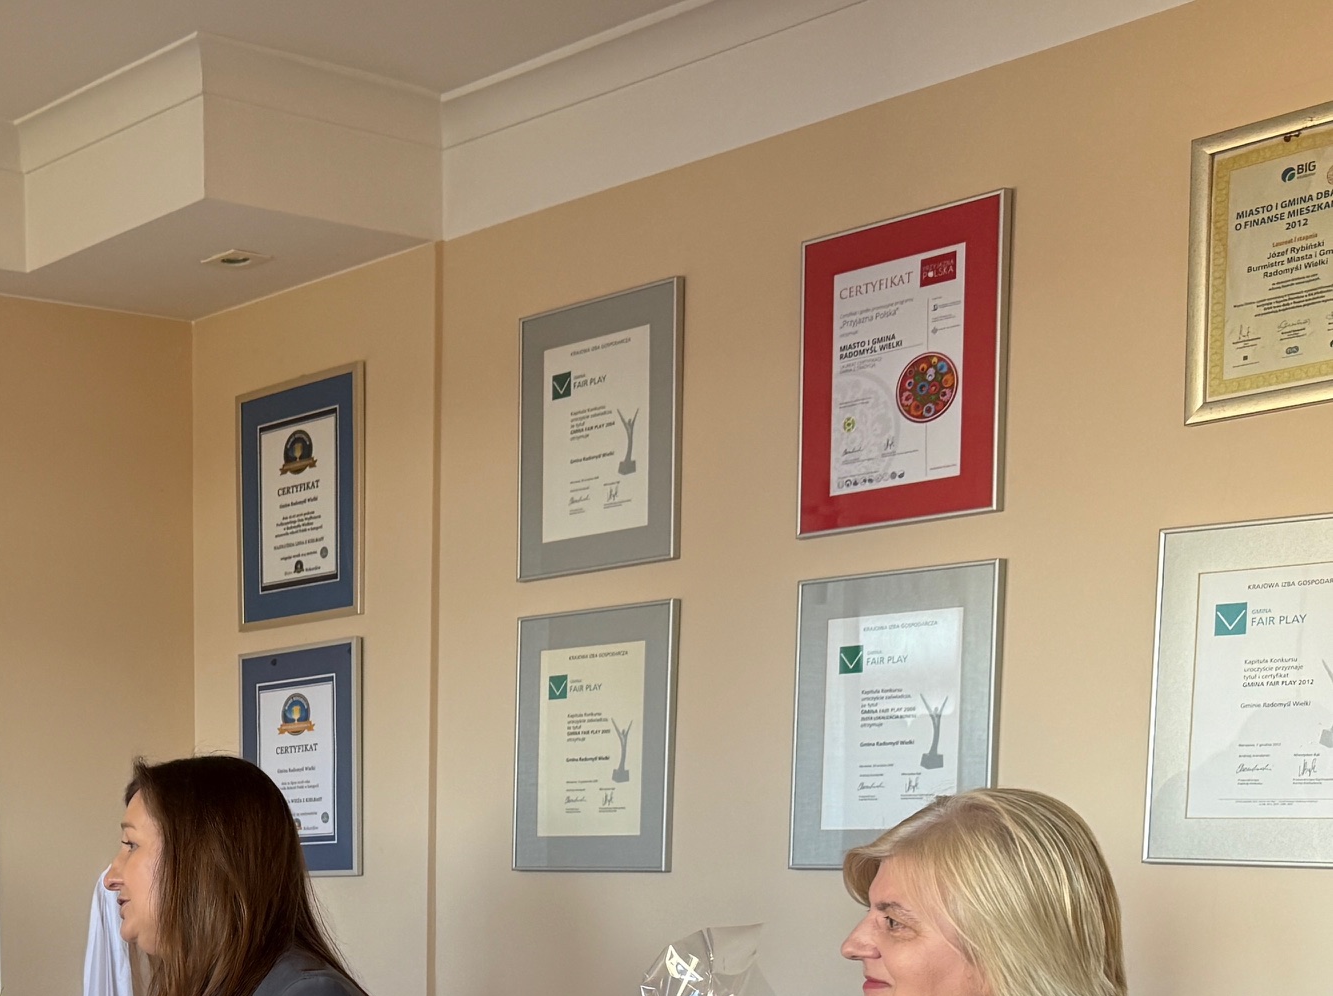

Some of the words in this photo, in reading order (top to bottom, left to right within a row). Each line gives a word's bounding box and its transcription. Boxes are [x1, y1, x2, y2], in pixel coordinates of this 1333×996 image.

[1297, 161, 1316, 174] BIG
[1236, 204, 1273, 220] MIASTO
[1275, 202, 1278, 210] I
[1281, 194, 1313, 209] GMINA
[1235, 223, 1242, 231] O
[1244, 212, 1285, 229] FINANSE
[1286, 218, 1309, 230] 2012
[1267, 248, 1288, 259] Józef
[1247, 260, 1285, 273] Burmistrz
[1287, 254, 1312, 264] Miasta
[1263, 264, 1302, 279] Radomyśl
[1304, 258, 1328, 269] Wielki
[923, 265, 953, 280] POLSKA
[839, 271, 914, 300] CERTYFIKAT
[840, 340, 865, 352] MIASTO
[872, 333, 896, 345] GMINA
[840, 346, 877, 360] RADOMYŚL
[879, 340, 903, 352] WIELKI
[573, 379, 588, 389] FAIR
[590, 374, 607, 386] PLAY
[277, 479, 320, 497] CERTYFIKAT
[1248, 582, 1280, 590] KRAJOWA
[1251, 616, 1275, 626] FAIR
[1279, 614, 1307, 624] PLAY
[866, 656, 885, 666] FAIR
[887, 655, 908, 664] PLAY
[586, 683, 602, 691] PLAY
[275, 742, 318, 755] CERTYFIKAT
